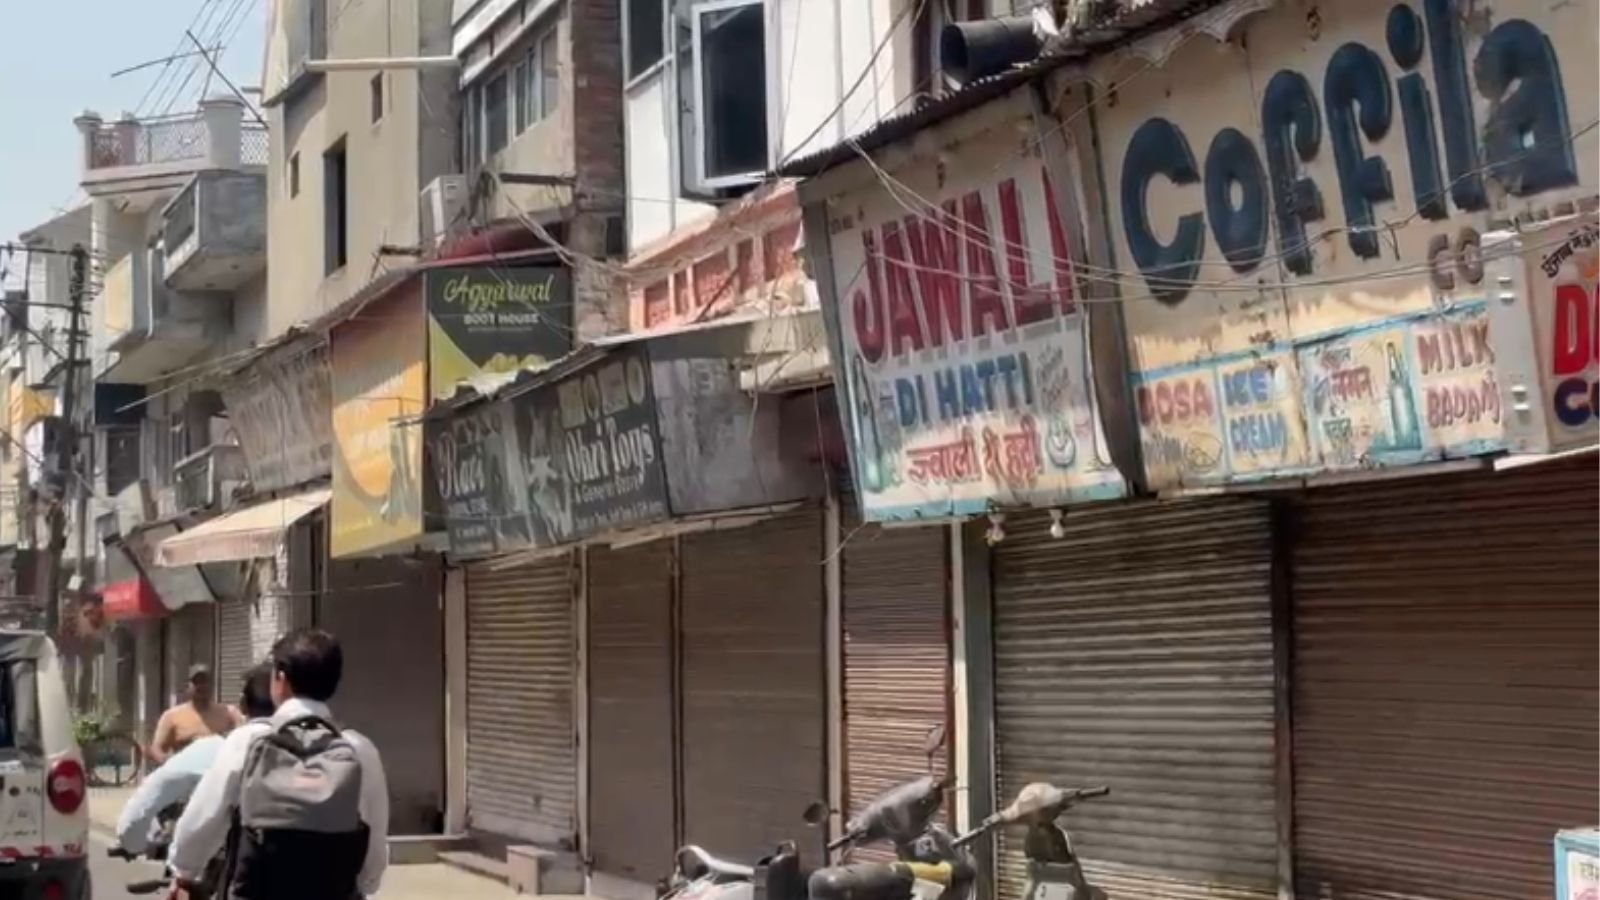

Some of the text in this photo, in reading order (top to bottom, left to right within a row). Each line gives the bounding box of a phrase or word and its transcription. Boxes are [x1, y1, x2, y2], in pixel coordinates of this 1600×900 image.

[852, 165, 1076, 364] JAWALI
[443, 273, 555, 312] Aggarwal
[463, 311, 540, 325] BOOT HOUSE
[1417, 323, 1495, 375] MILK
[1553, 284, 1600, 375] D
[895, 374, 930, 427] DI
[934, 351, 1033, 421] HATTI
[1222, 366, 1271, 407] ICE
[1426, 375, 1501, 429] BADAM
[605, 416, 655, 486] Toys
[1229, 411, 1289, 458] CREAM
